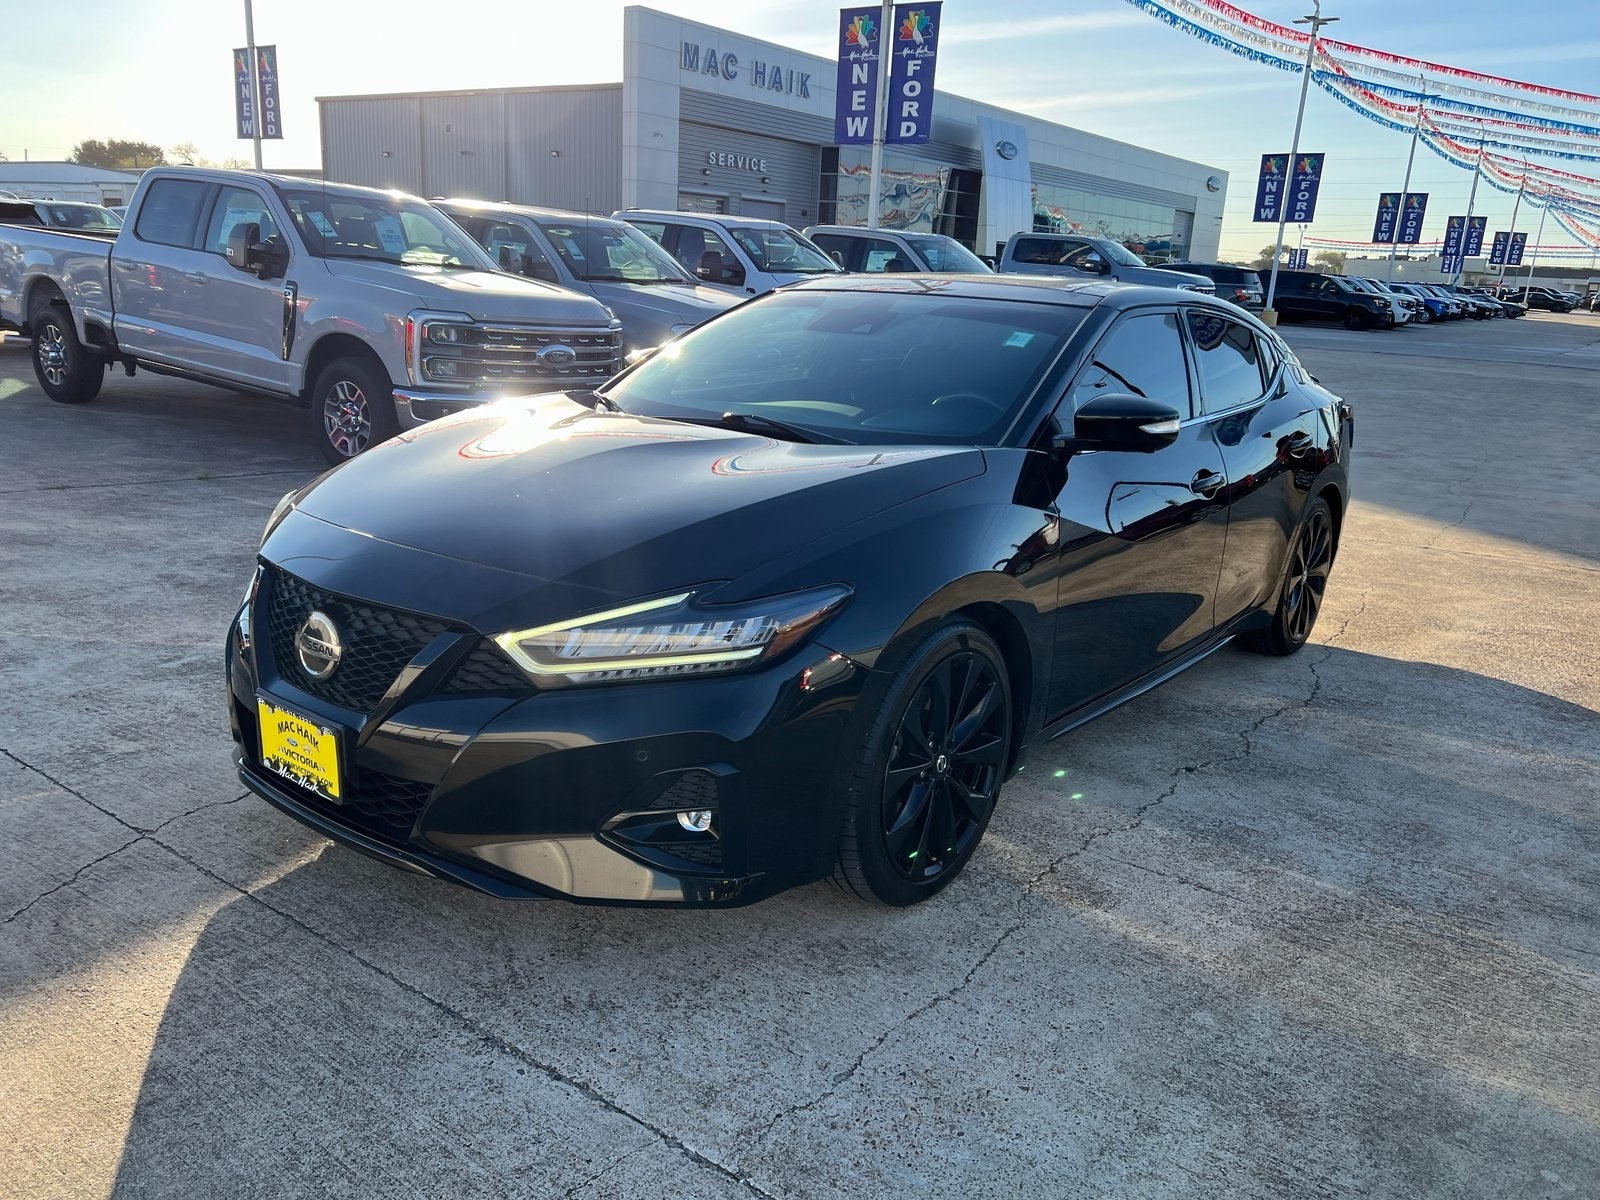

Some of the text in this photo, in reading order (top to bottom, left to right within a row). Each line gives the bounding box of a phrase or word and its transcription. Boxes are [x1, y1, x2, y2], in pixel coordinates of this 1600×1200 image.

[680, 41, 811, 98] MAC HAIK
[241, 84, 252, 134] NEW
[265, 83, 276, 135] FORD
[846, 63, 869, 137] NEW
[899, 60, 922, 137] FORD
[709, 151, 767, 172] SERVICE
[1260, 181, 1278, 219] NEW
[1294, 181, 1311, 220] FORD
[1377, 212, 1392, 241] NEW
[1404, 213, 1418, 242] FORD
[1446, 231, 1458, 254] NEW
[1468, 231, 1479, 255] FORD
[1493, 244, 1504, 263] NEW
[1510, 245, 1520, 264] FORD
[1442, 260, 1450, 273] NEW
[301, 637, 334, 657] NISSAN
[277, 720, 296, 735] MAC
[296, 723, 321, 752] HAIK
[278, 763, 295, 781] Mac
[282, 747, 320, 772] VICTORIA
